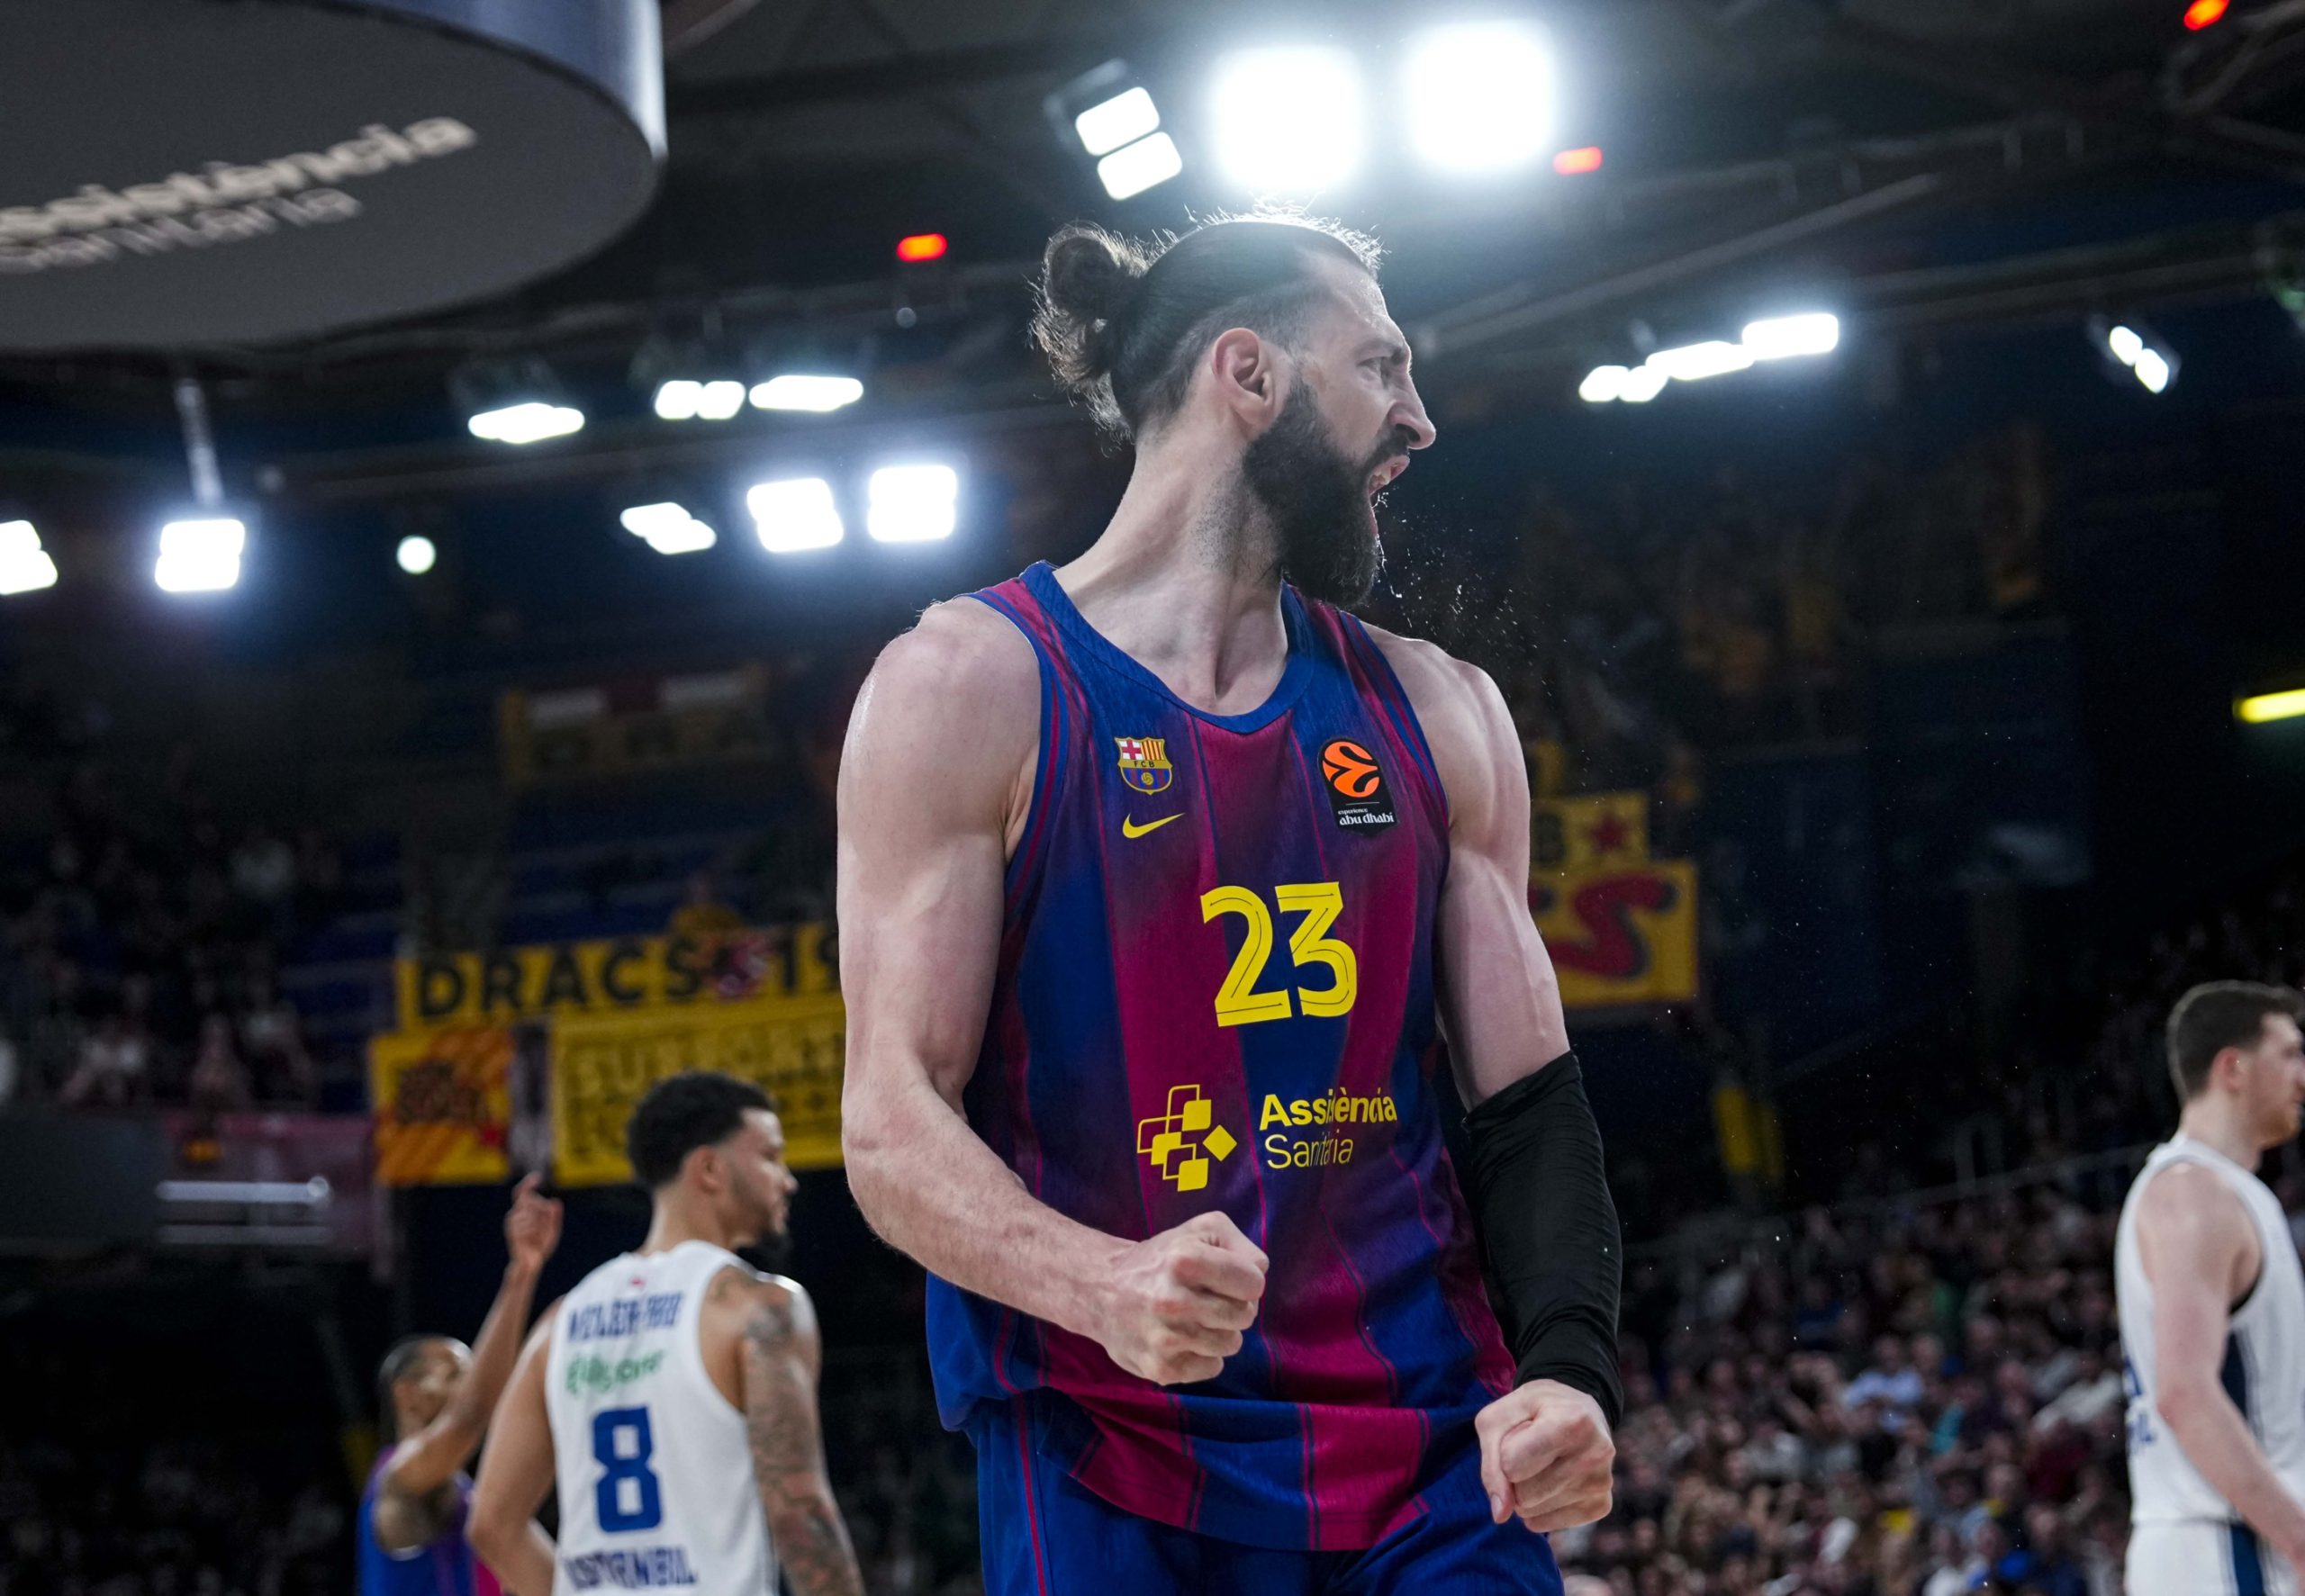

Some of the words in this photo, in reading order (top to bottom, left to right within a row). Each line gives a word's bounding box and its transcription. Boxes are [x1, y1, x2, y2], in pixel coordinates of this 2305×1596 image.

[1337, 807, 1369, 816] experience
[1339, 815, 1362, 825] abu
[1362, 812, 1395, 824] dhabi
[419, 933, 702, 1017] DRACS
[1200, 881, 1357, 1027] 23
[592, 1406, 663, 1533] 8
